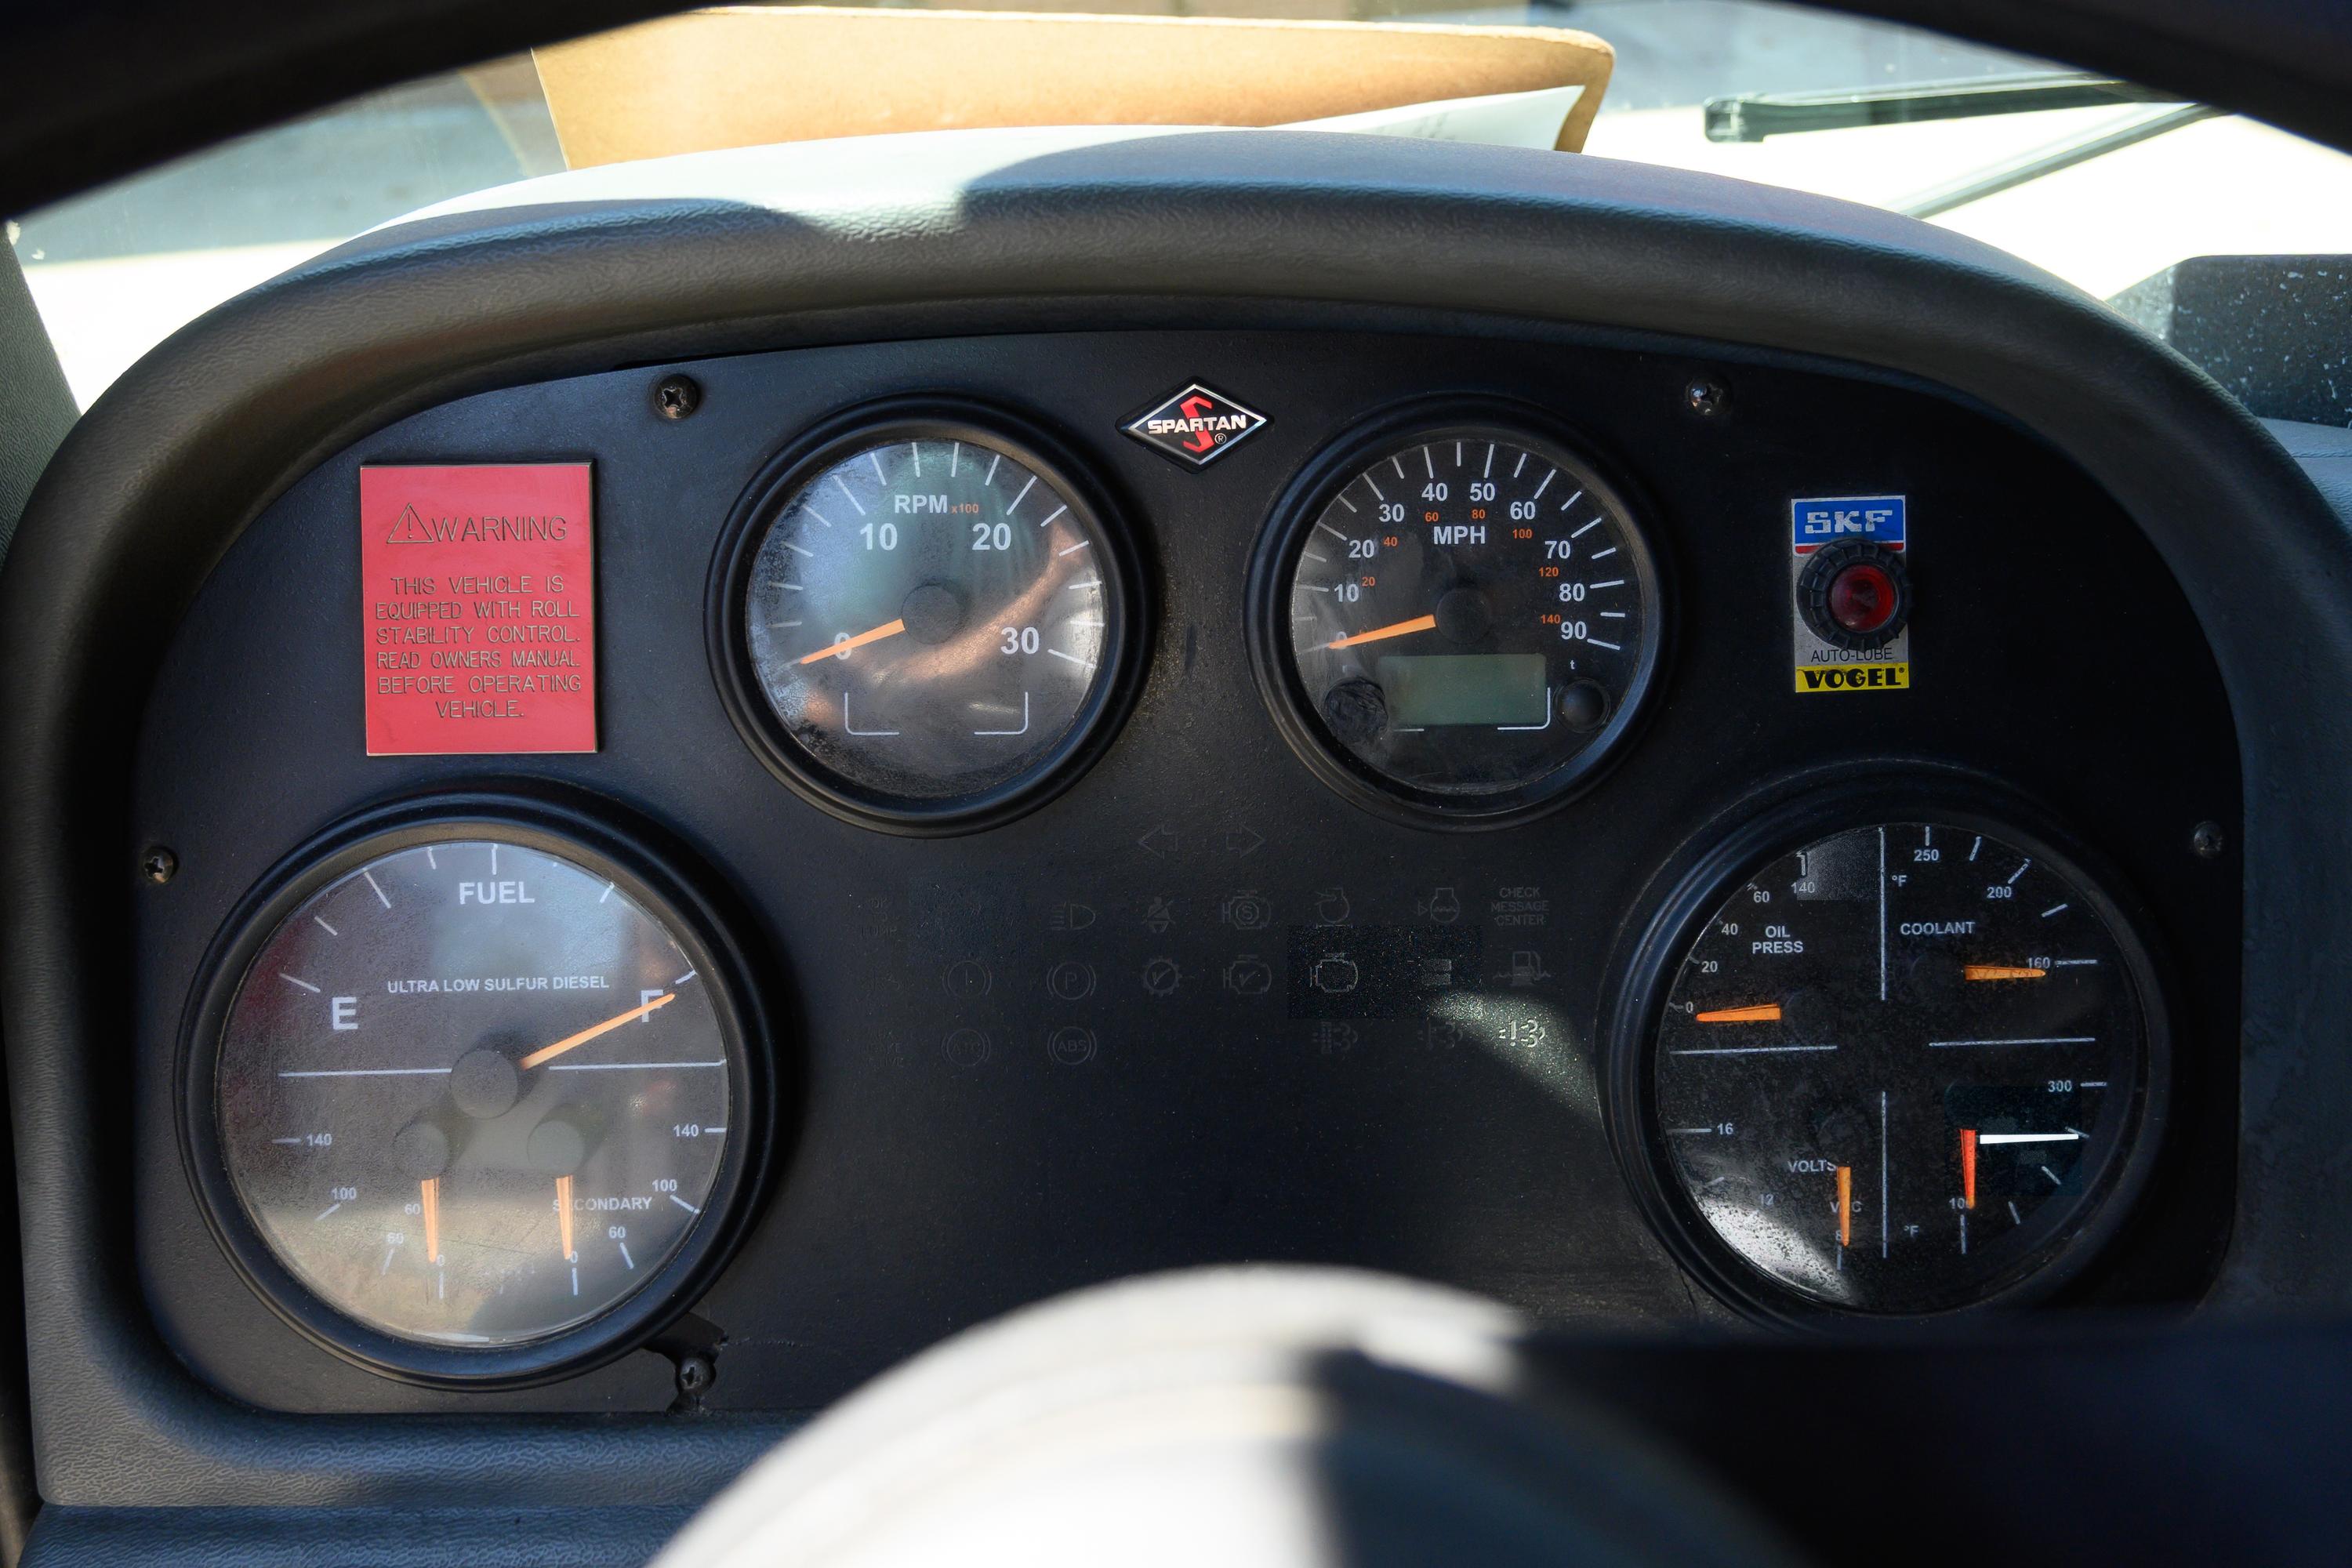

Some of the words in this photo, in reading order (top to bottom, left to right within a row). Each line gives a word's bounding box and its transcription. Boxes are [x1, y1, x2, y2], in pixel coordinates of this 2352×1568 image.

[1148, 415, 1247, 434] SPARTAN
[1421, 482, 1448, 502] 40
[1469, 482, 1496, 502] 50
[895, 495, 948, 514] RPM
[951, 503, 979, 514] x100
[1510, 501, 1537, 521] 60
[1378, 503, 1405, 523] 30
[1425, 511, 1439, 523] 60
[1472, 508, 1486, 520] 80
[431, 515, 568, 543] WARNING
[1805, 510, 1893, 535] SKF
[860, 523, 898, 550] 10
[972, 523, 1011, 550] 20
[1433, 525, 1486, 545] MPH
[1512, 528, 1533, 539] 100
[1383, 536, 1398, 547] 40
[1348, 540, 1375, 559] 20
[1544, 540, 1571, 560] 70
[1538, 567, 1559, 578] 120
[390, 576, 437, 595] THIS
[448, 575, 532, 594] VEHICLE
[546, 574, 564, 593] IS
[1362, 576, 1376, 587] 20
[1334, 584, 1359, 602] 10
[1559, 583, 1586, 603] 80
[376, 601, 463, 619] EQUIPPED
[474, 601, 521, 619] WITH
[532, 600, 580, 618] ROLL
[1540, 614, 1561, 625] 140
[376, 626, 474, 644] STABILITY
[487, 625, 580, 643] CONTROL.
[1560, 621, 1588, 641] 90
[1000, 627, 1040, 655] 30
[376, 651, 422, 670] READ
[431, 650, 502, 669] OWNERS
[1811, 648, 1893, 663] AUTO-LUBE
[378, 675, 456, 694] BEFORE
[469, 674, 582, 693] OPERATING
[436, 699, 524, 718] VEHICLE.
[1914, 849, 1940, 862] 250
[459, 880, 535, 905] FUEL
[1499, 887, 1541, 898] CHECK
[1791, 881, 1816, 895] 140
[1987, 886, 2013, 899] 200
[1753, 891, 1770, 903] 60
[1491, 900, 1550, 913] MESSAGE
[1496, 914, 1544, 927] CENTER
[1721, 923, 1738, 935] 40
[1765, 925, 1791, 938] OIL
[1900, 921, 1976, 936] COOLANT
[1751, 941, 1804, 955] PRESS
[1701, 960, 1719, 974] 20
[387, 979, 439, 993] ULTRA
[444, 978, 480, 993] LOW
[484, 977, 549, 991] SULFUR
[553, 975, 610, 990] DIESEL
[641, 989, 664, 1023] F
[1686, 1000, 1694, 1014] 0
[332, 996, 358, 1031] E
[1057, 1039, 1087, 1053] ABS
[2048, 1080, 2072, 1093] 300
[673, 1123, 699, 1137] 140
[1717, 1122, 1734, 1135] 16
[307, 1133, 332, 1146] 140
[1788, 1160, 1838, 1173] VOLTS
[652, 1178, 678, 1192] 100
[331, 1187, 357, 1200] 100
[404, 1203, 421, 1215] 60
[552, 1196, 652, 1211] SCONDARY
[1830, 1200, 1864, 1214] VC
[1949, 1197, 1969, 1210] 10
[608, 1226, 626, 1239] 60
[570, 1250, 579, 1264] 0
